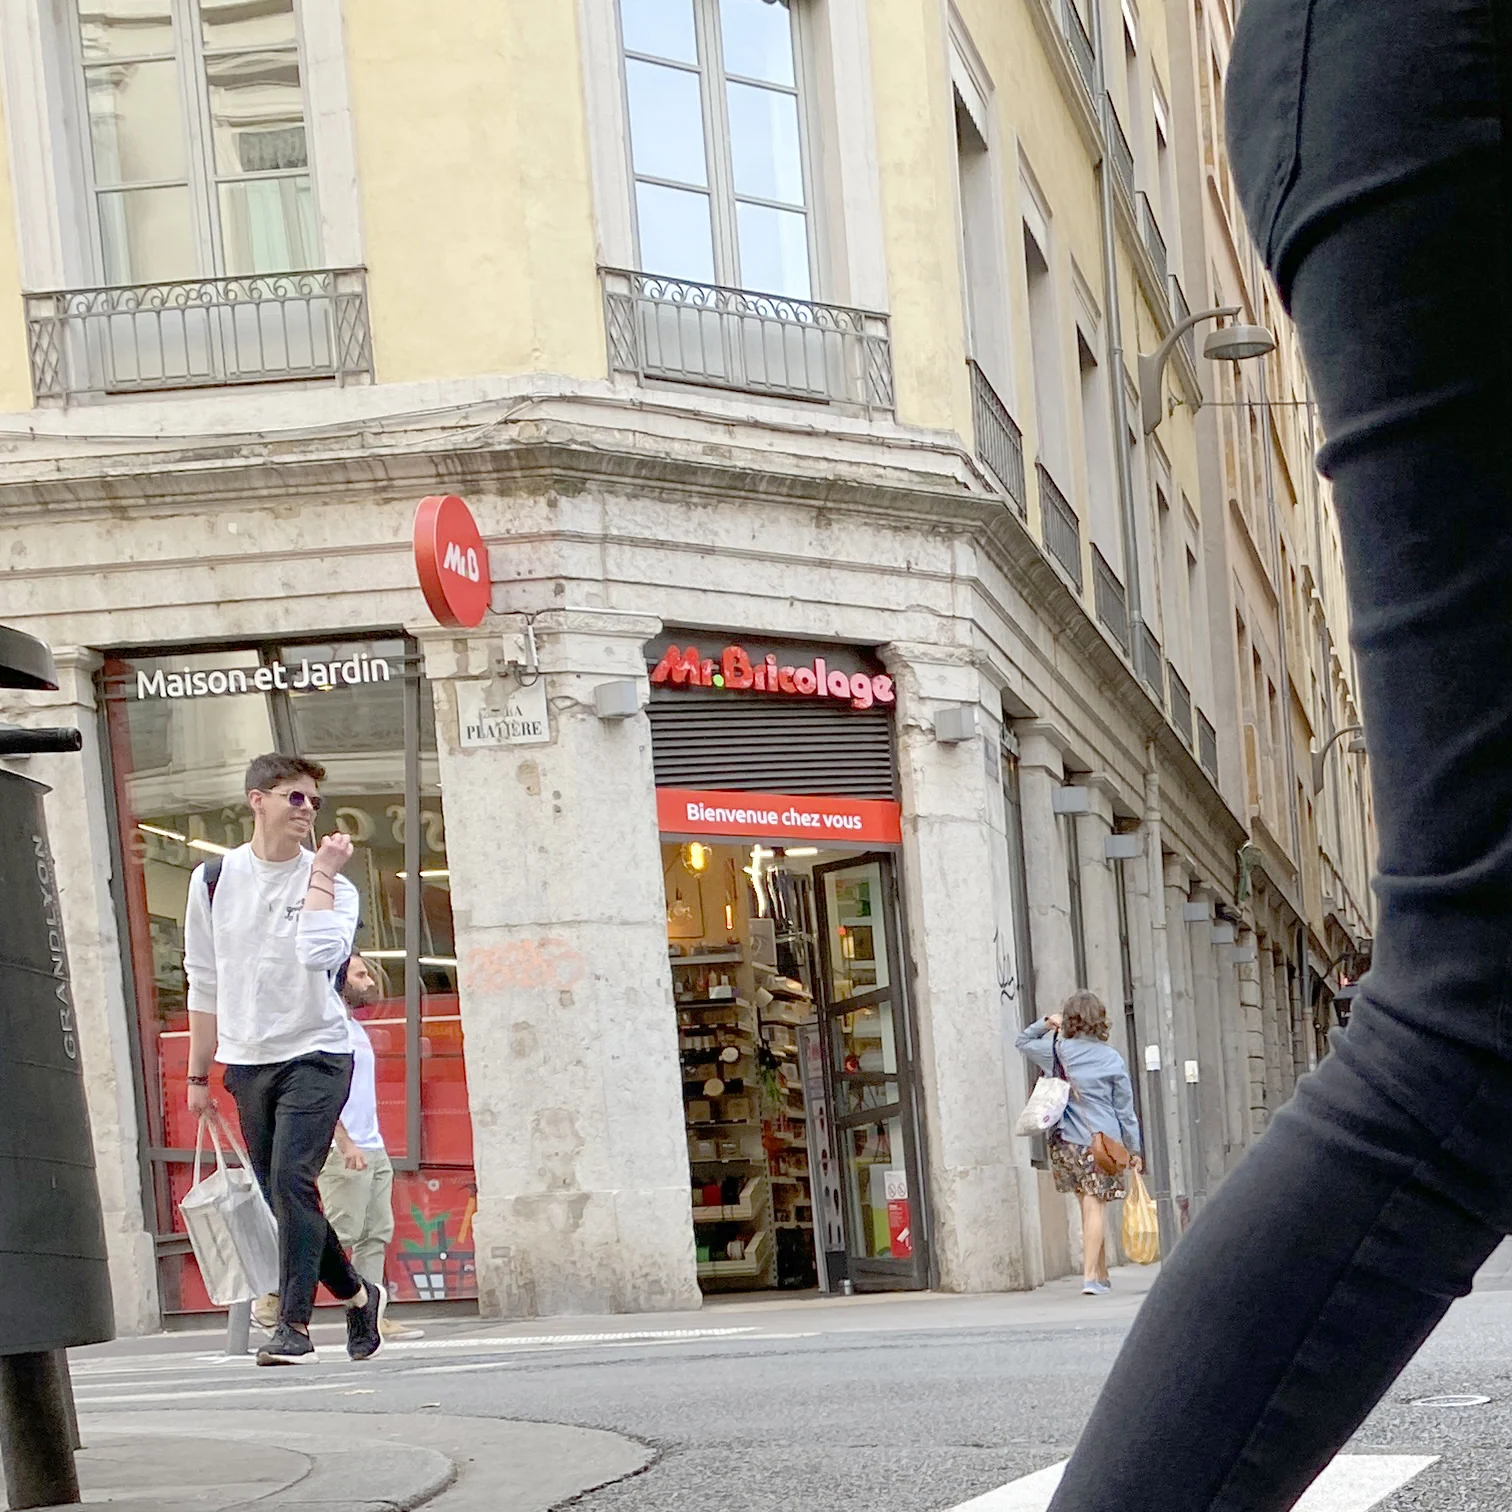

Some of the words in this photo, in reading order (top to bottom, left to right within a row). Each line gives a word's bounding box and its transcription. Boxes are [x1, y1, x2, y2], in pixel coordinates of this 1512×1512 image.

[137, 666, 248, 699] Maison
[254, 661, 288, 690] et
[293, 653, 389, 688] Jardin
[686, 803, 779, 825] Bienvenue
[782, 807, 821, 827] chez
[822, 814, 862, 829] vous
